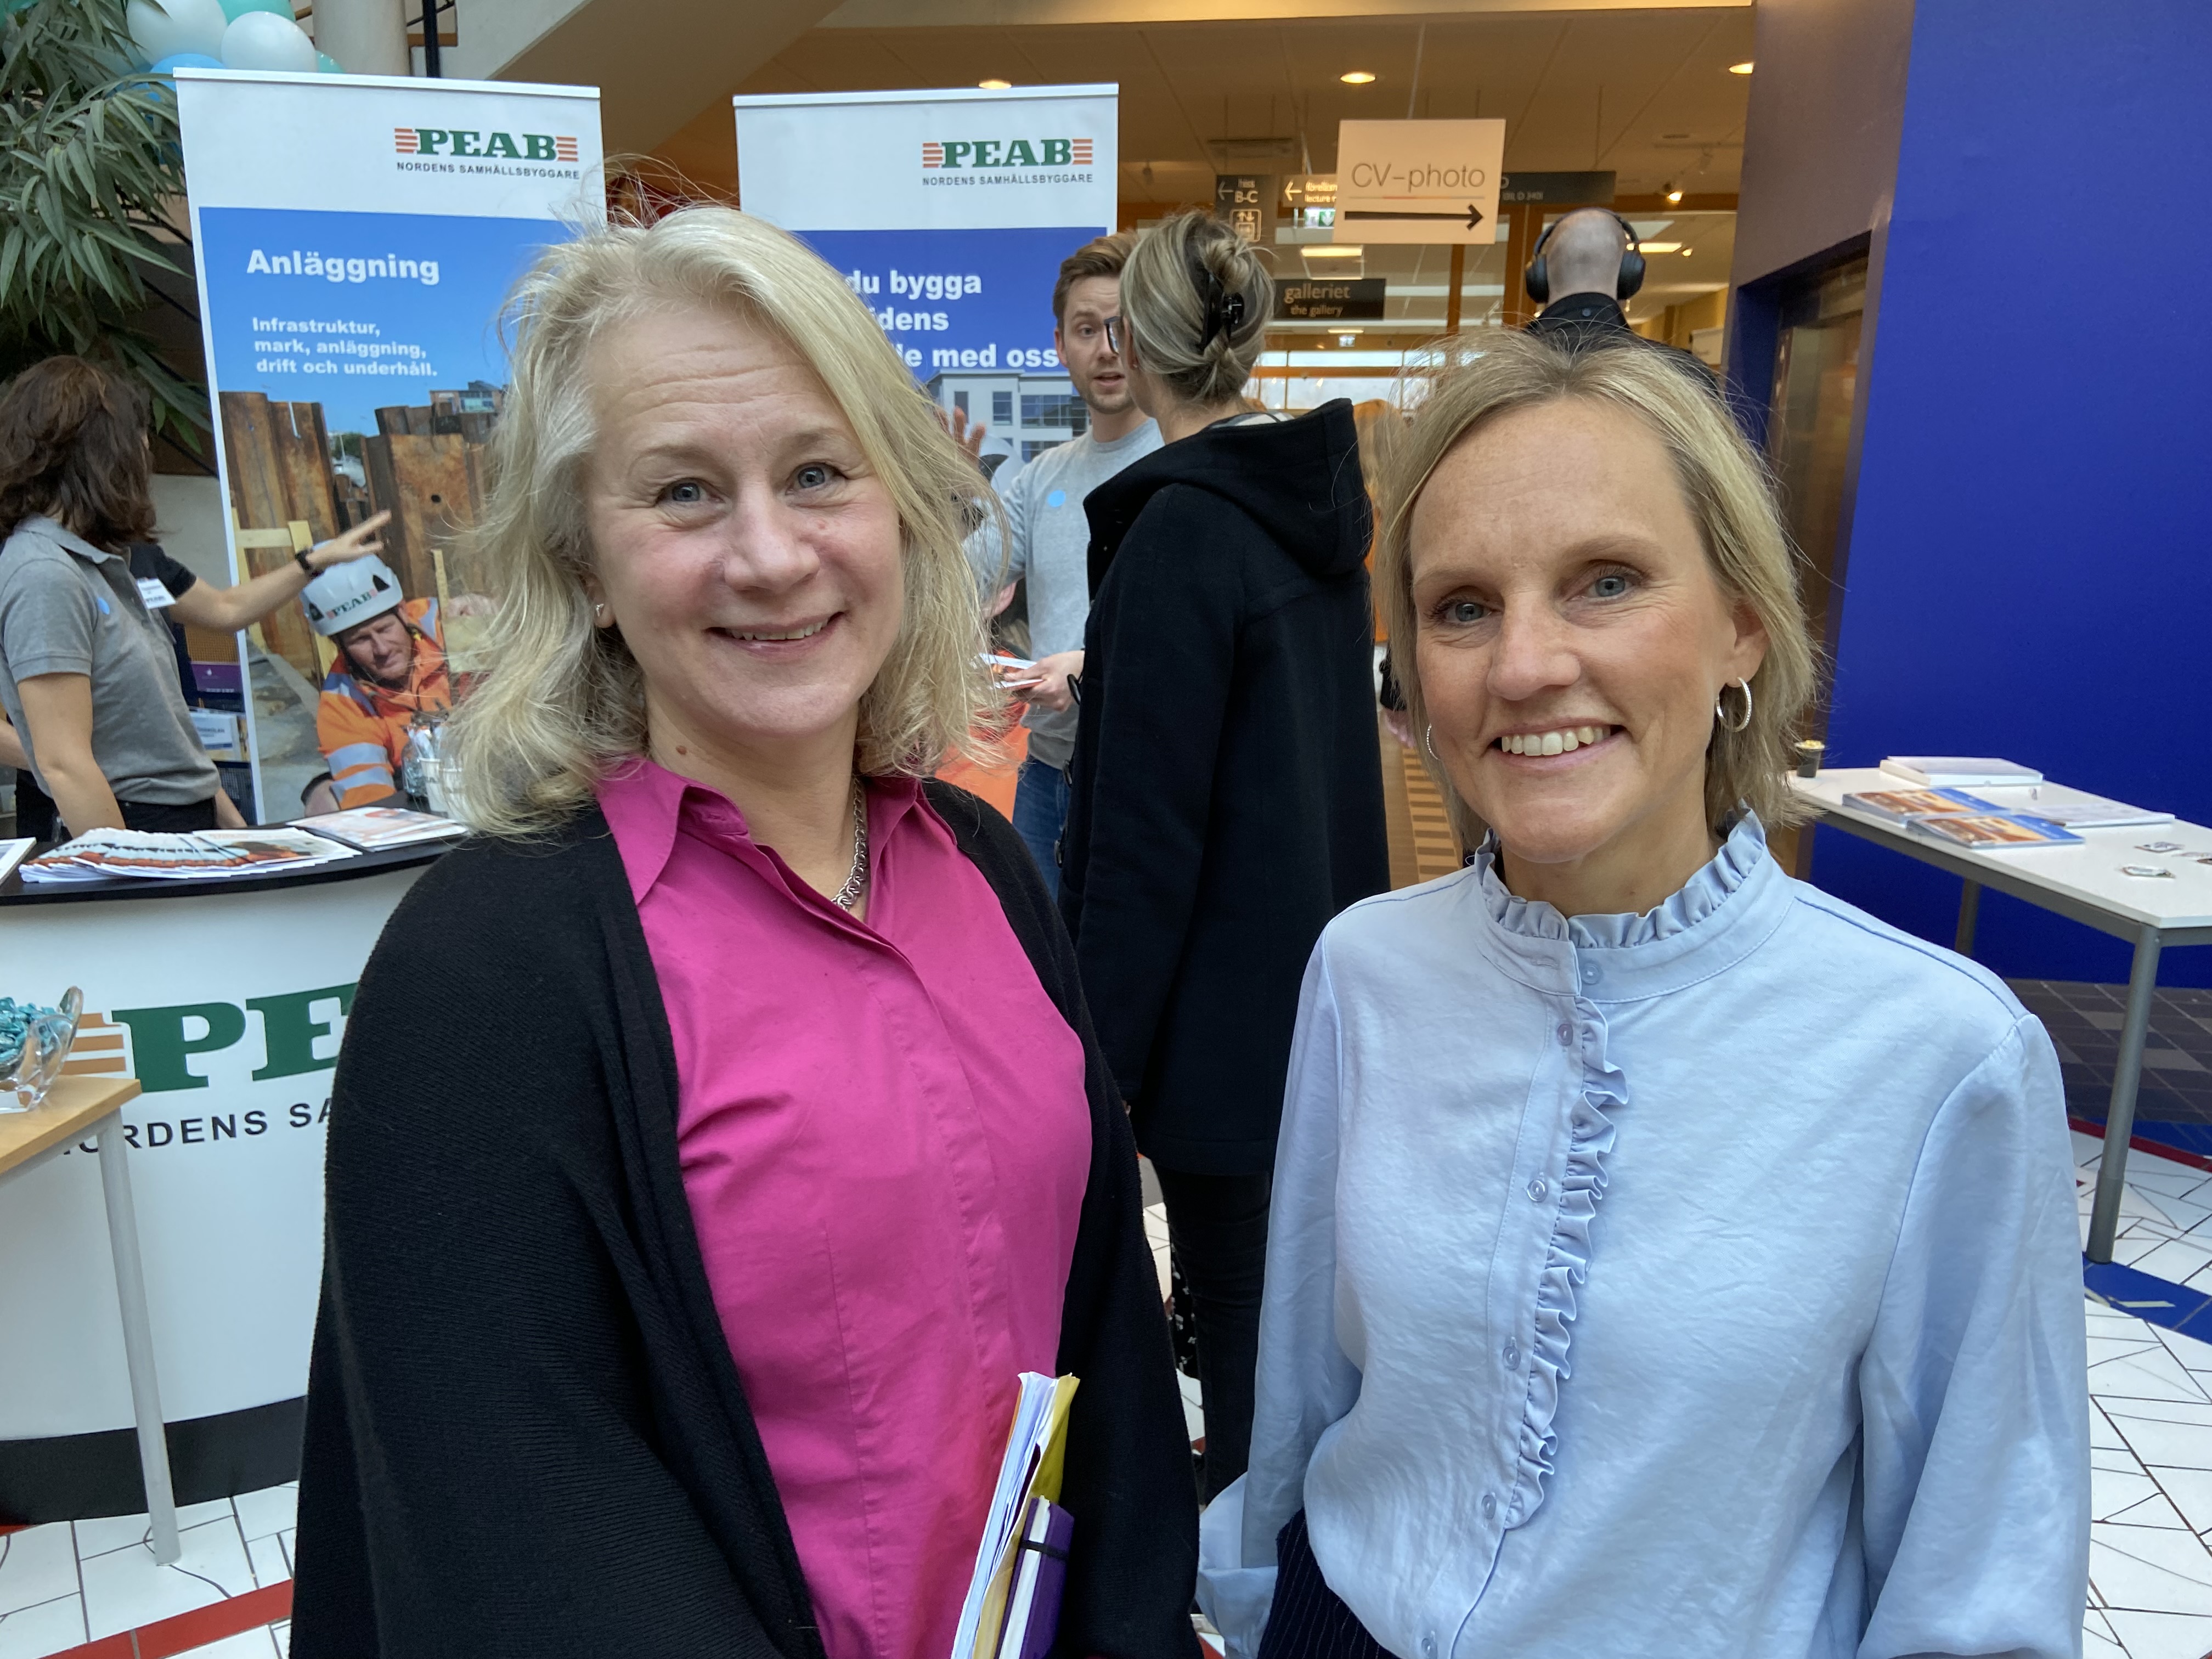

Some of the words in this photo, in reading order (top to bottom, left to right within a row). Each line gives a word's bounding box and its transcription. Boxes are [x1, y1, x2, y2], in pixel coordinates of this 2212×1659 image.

[415, 128, 557, 161] PEAB
[941, 138, 1072, 169] PEAB
[397, 161, 455, 173] NORDENS
[459, 164, 580, 180] SAMHÄLLSBYGGARE
[922, 176, 976, 186] NORDENS
[979, 173, 1094, 185] SAMHÄLLSBYGGARE
[1351, 162, 1486, 193] CV-photo
[1234, 190, 1259, 203] B-C
[246, 249, 440, 286] Anläggning
[844, 269, 880, 294] du
[889, 269, 983, 300] bygga
[1284, 283, 1351, 303] galleriet
[1290, 304, 1307, 315] the
[1309, 305, 1344, 318] gallery
[252, 317, 381, 338] Infrastruktur,
[255, 338, 311, 356] mark,
[316, 340, 427, 359] anläggning,
[933, 343, 997, 368] med
[1006, 347, 1060, 368] oss
[256, 358, 297, 374] drift
[303, 359, 338, 374] och
[343, 360, 438, 377] underhåll.
[331, 591, 372, 617] PEAB
[64, 1110, 268, 1156] RDENS
